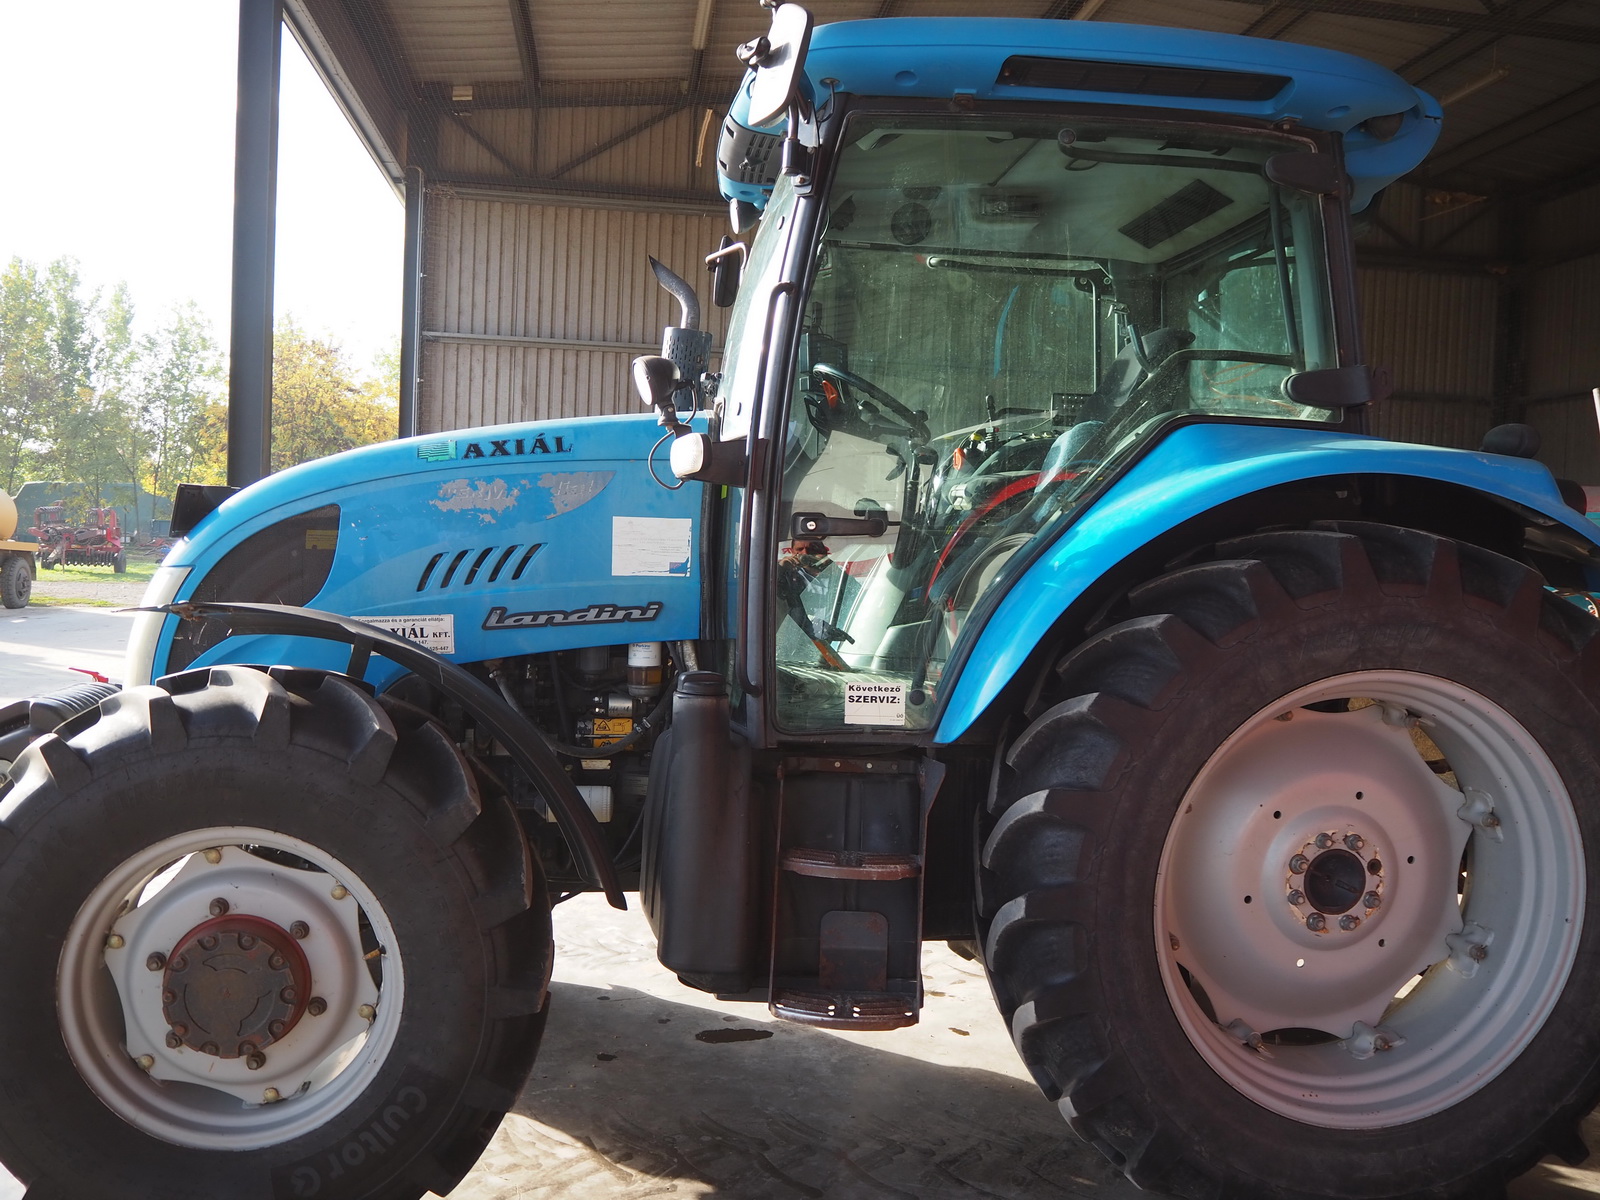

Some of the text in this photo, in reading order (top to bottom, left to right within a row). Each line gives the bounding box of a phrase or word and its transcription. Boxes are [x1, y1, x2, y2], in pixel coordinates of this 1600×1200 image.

[461, 433, 574, 460] AXIÁL
[484, 603, 661, 629] Landini
[390, 623, 429, 639] XIÁL
[848, 684, 901, 693] Következő
[848, 695, 900, 704] SZERVIZ:
